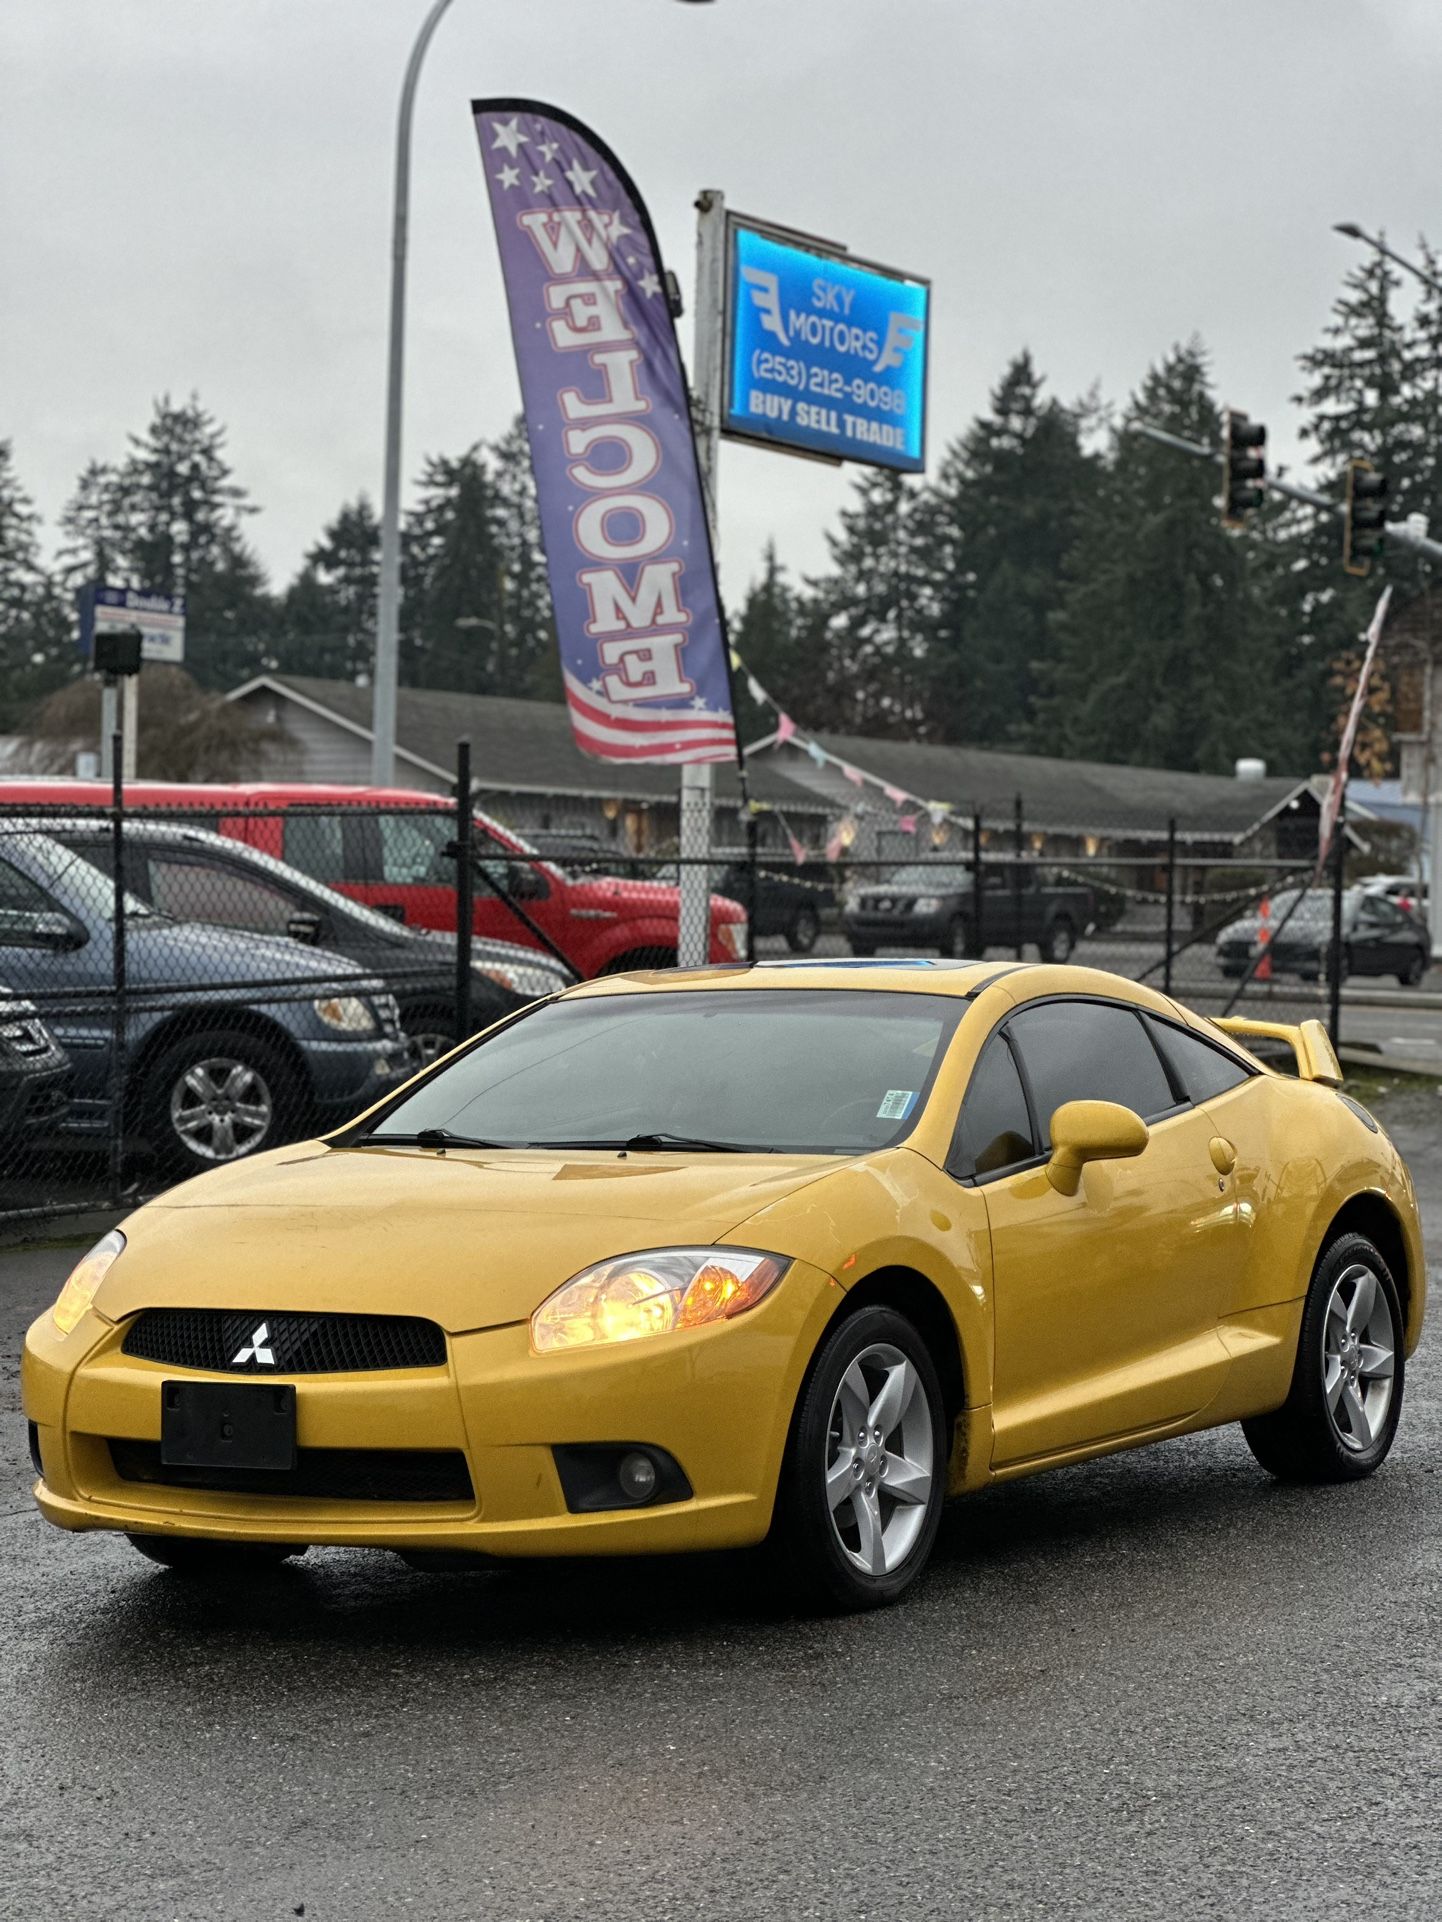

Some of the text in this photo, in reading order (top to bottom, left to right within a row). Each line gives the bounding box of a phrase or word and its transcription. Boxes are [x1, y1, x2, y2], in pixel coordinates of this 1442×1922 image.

[811, 279, 855, 314] SKY
[790, 309, 878, 361] MOTORS
[752, 350, 906, 414] (253) 212-9098
[750, 390, 906, 449] BUY SELL TRADE
